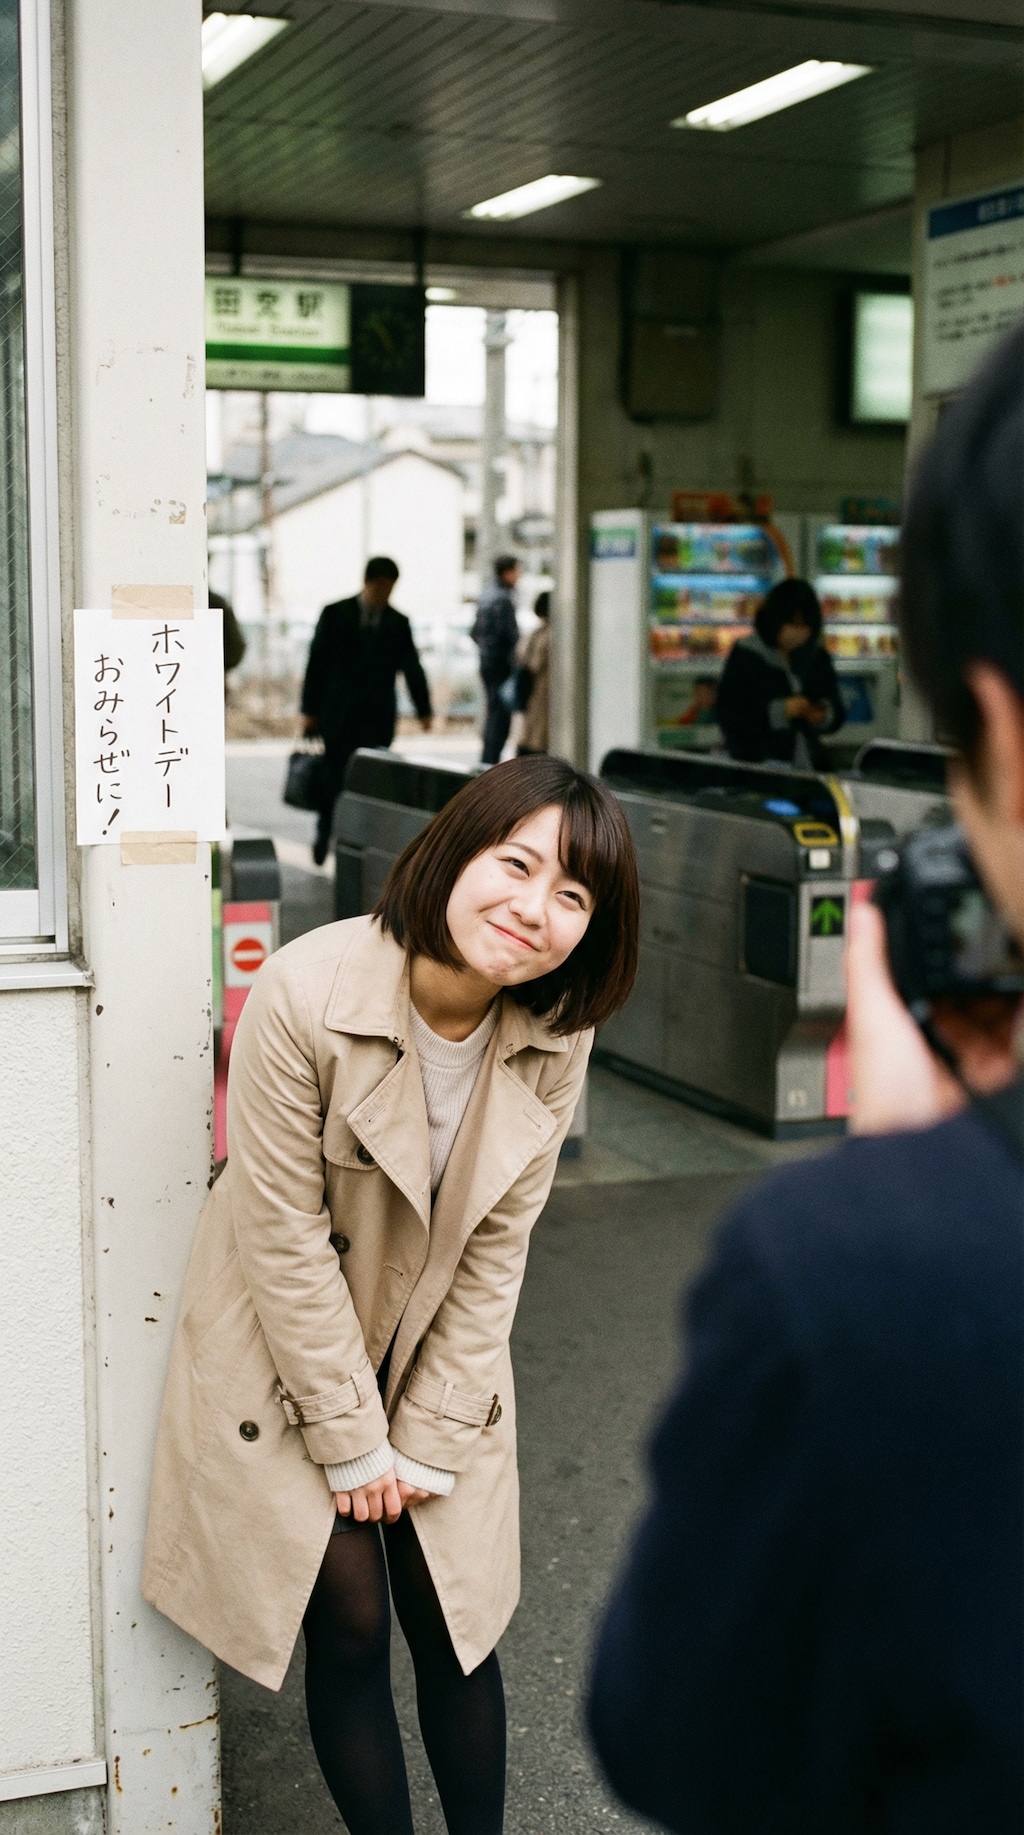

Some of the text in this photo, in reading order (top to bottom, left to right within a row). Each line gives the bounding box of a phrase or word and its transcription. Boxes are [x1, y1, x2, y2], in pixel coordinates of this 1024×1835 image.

[151, 623, 189, 808] ホワイトデー
